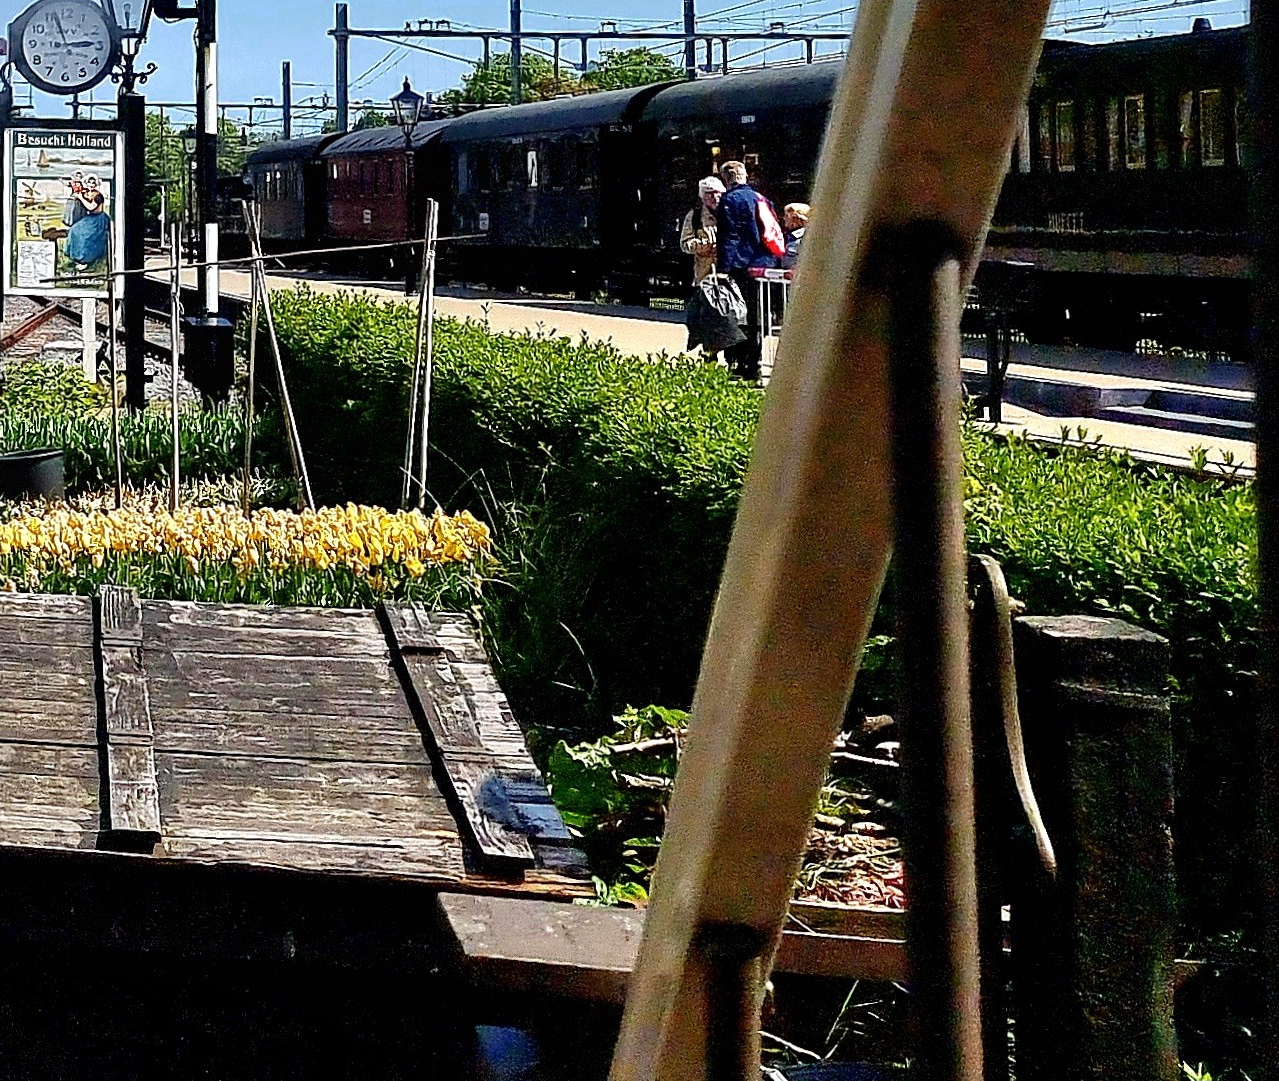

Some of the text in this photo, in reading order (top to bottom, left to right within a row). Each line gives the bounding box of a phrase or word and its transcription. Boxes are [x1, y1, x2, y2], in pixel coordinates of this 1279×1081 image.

[61, 8, 74, 19] 12
[32, 24, 44, 34] 10
[91, 25, 99, 35] 2
[28, 39, 37, 48] 9
[95, 41, 103, 50] 3
[33, 55, 41, 65] 8
[90, 57, 99, 66] 4
[45, 66, 53, 76] 7
[79, 68, 87, 77] 5
[61, 72, 69, 82] 6
[17, 133, 111, 147] Besucht Holland
